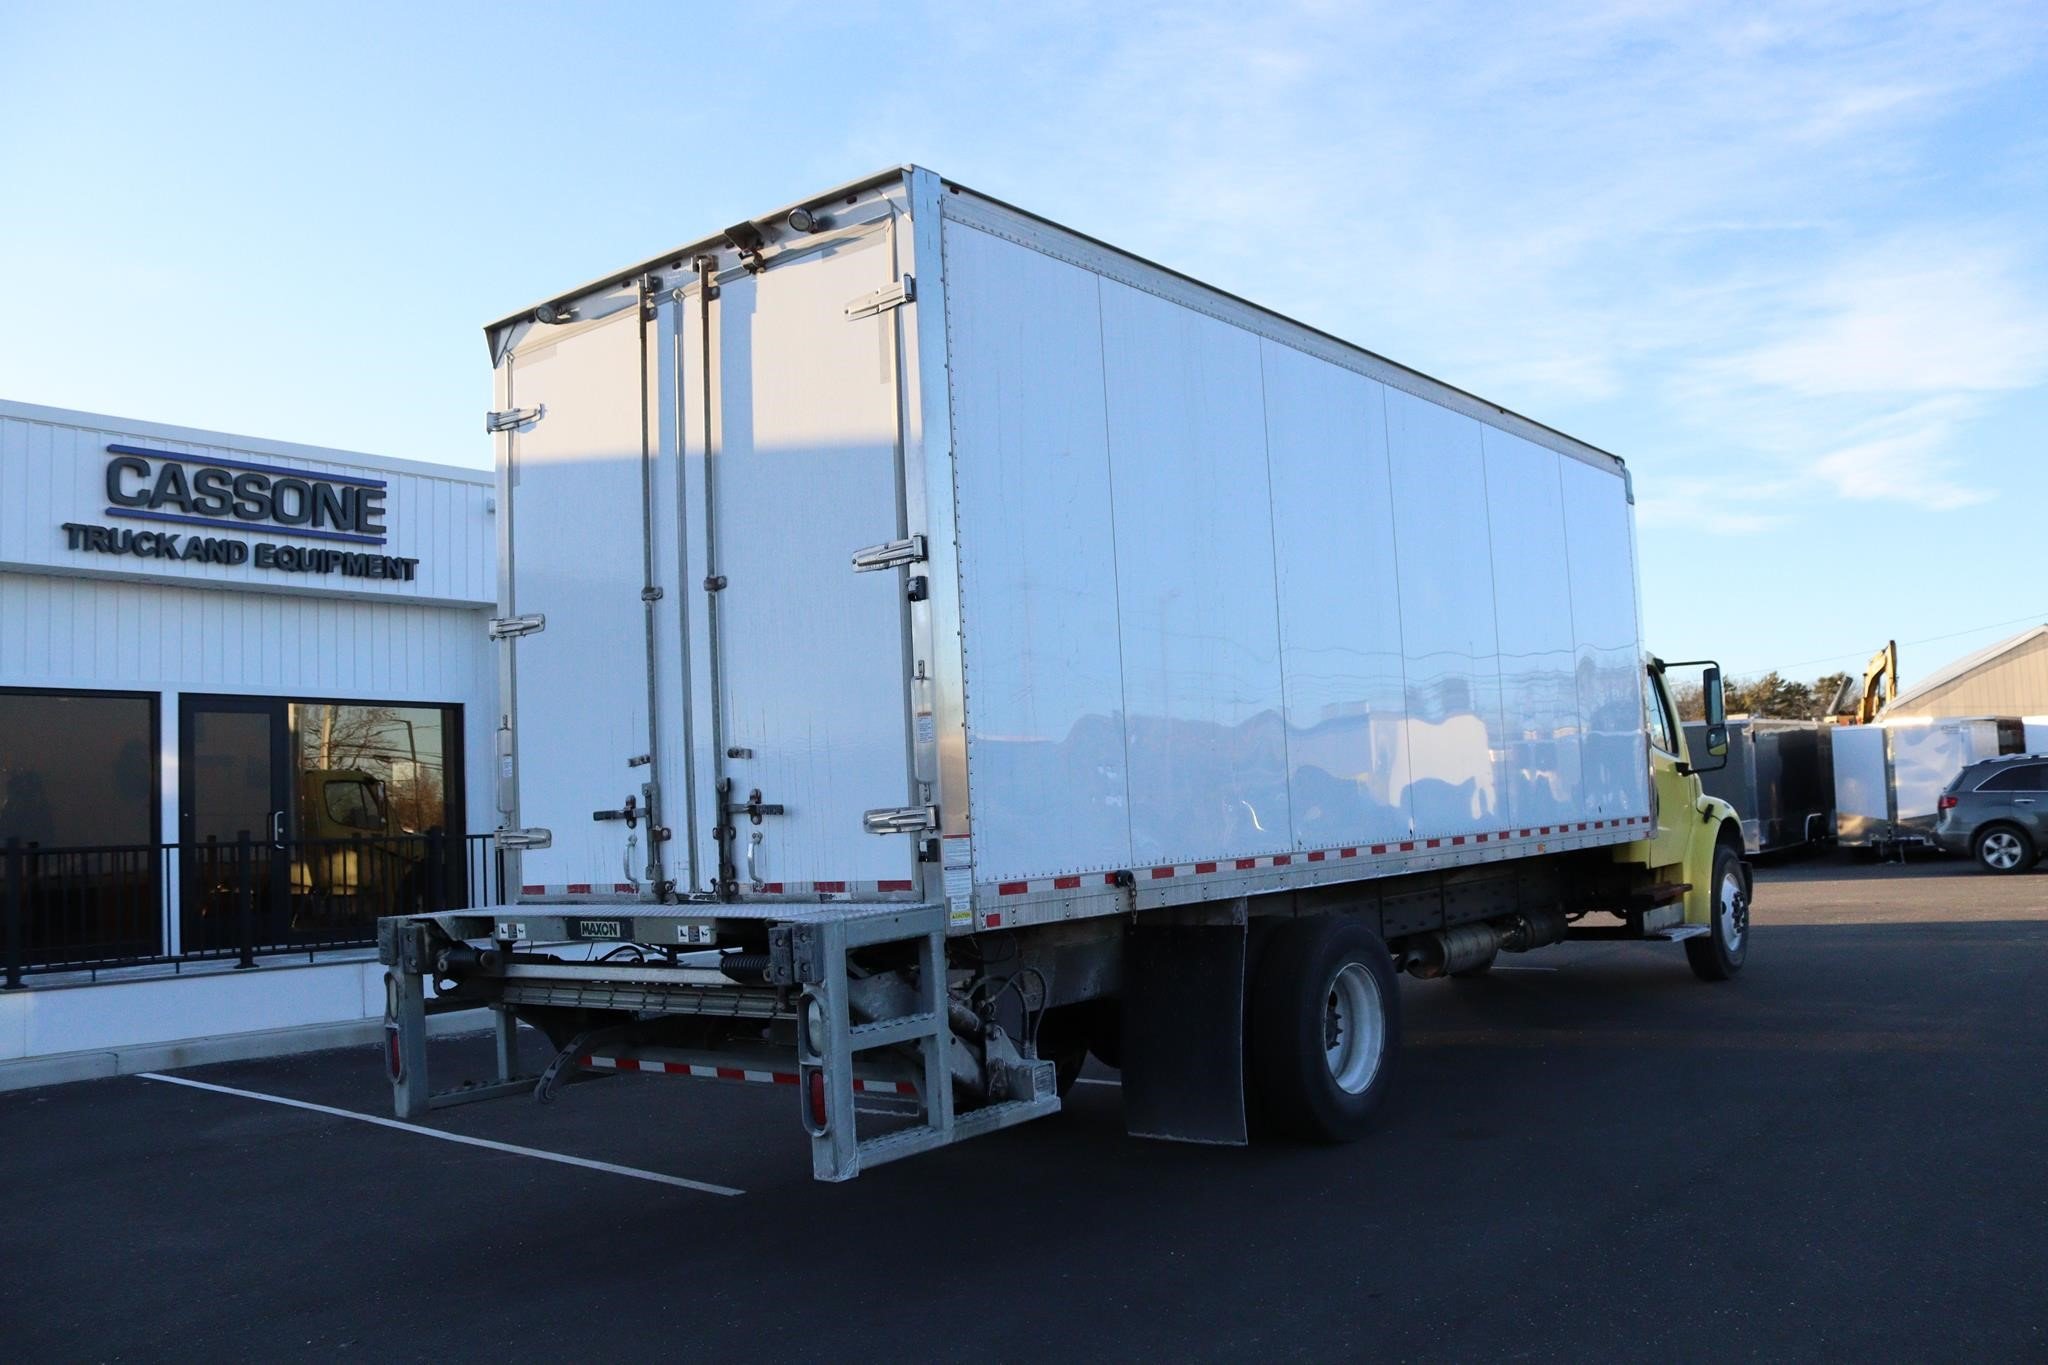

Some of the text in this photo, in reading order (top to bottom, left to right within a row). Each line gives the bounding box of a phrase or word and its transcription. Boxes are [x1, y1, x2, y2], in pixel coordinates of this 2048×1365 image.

[106, 457, 387, 534] CASSONE
[62, 523, 420, 581] TRUCK AND EQUIPMENT
[582, 922, 618, 936] MAXON
